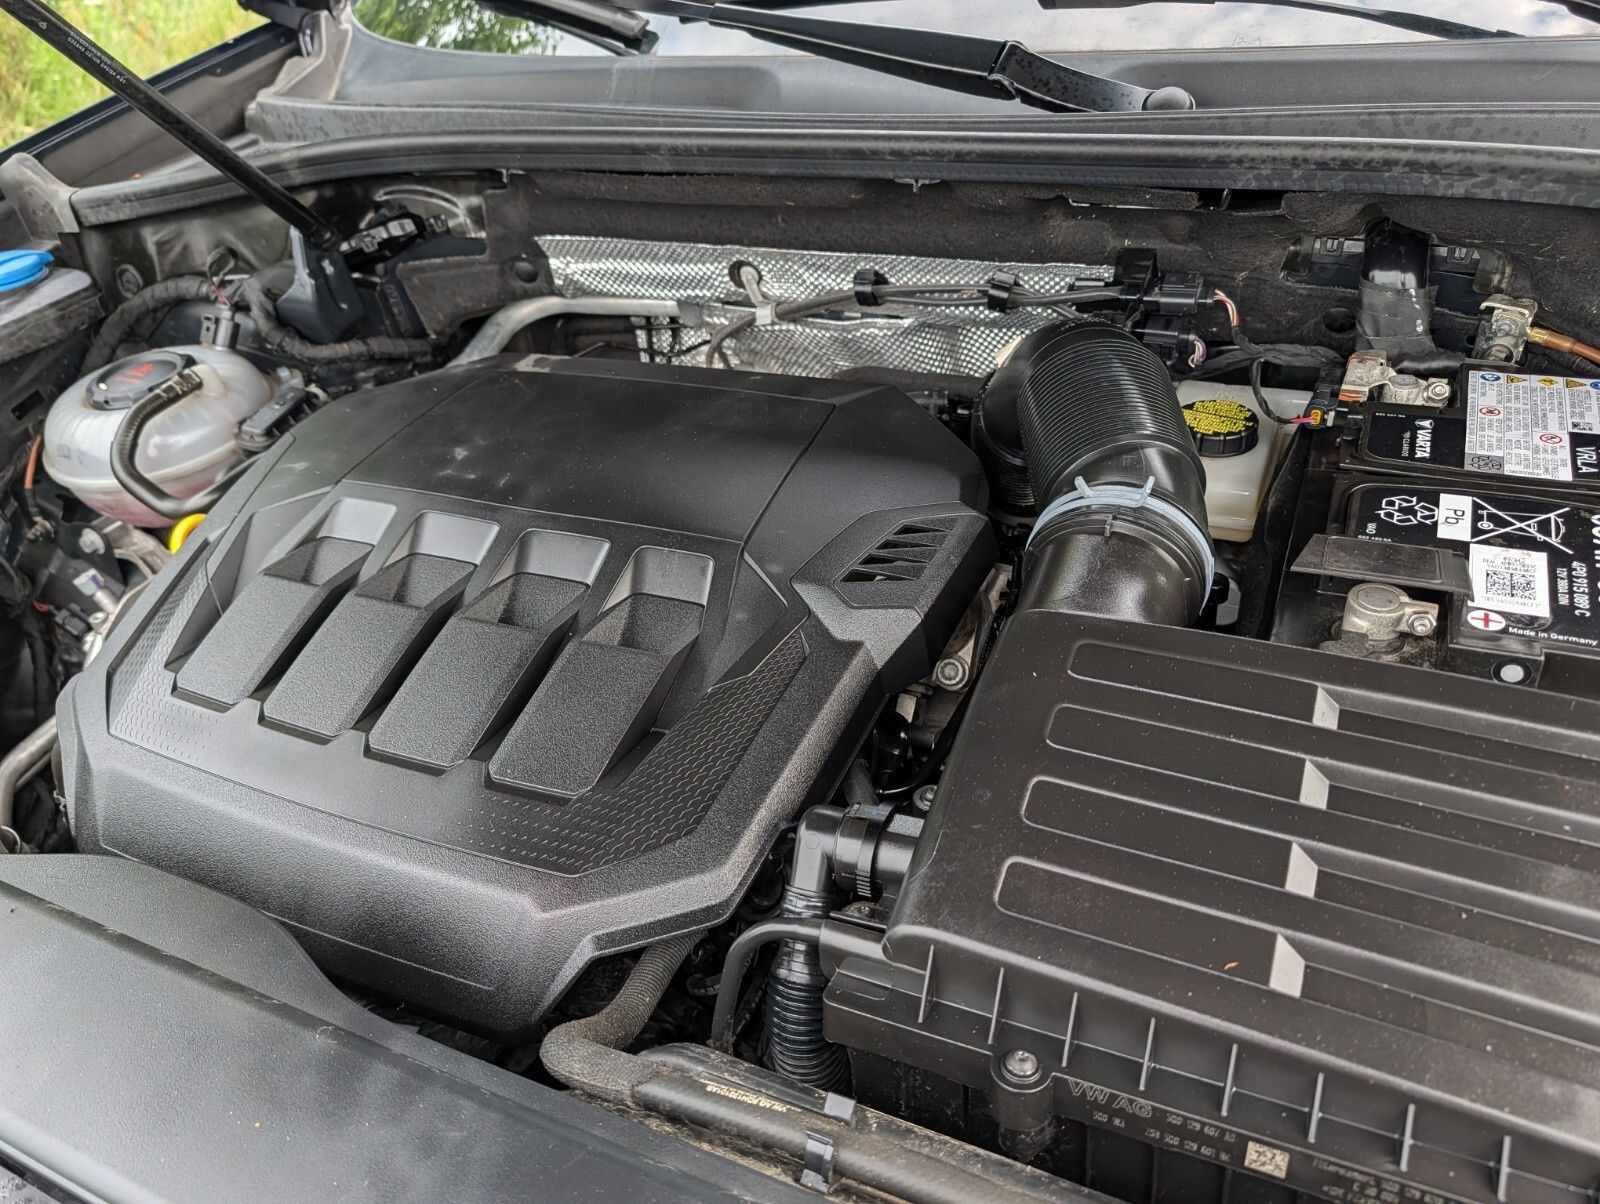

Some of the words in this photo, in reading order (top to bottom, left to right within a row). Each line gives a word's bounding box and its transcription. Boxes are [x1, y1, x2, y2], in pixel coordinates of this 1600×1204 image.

[1415, 429, 1432, 458] VARTA
[1575, 447, 1599, 472] VRLA
[1445, 508, 1465, 525] Pb
[1571, 561, 1587, 577] 4P0
[1572, 577, 1589, 593] 915
[1558, 593, 1570, 606] DIN
[1573, 593, 1590, 609] 089
[1574, 609, 1591, 617] C
[1508, 627, 1536, 637] Made
[1550, 632, 1598, 646] Germany
[1068, 1079, 1110, 1104] VW
[1112, 1095, 1152, 1118] AG
